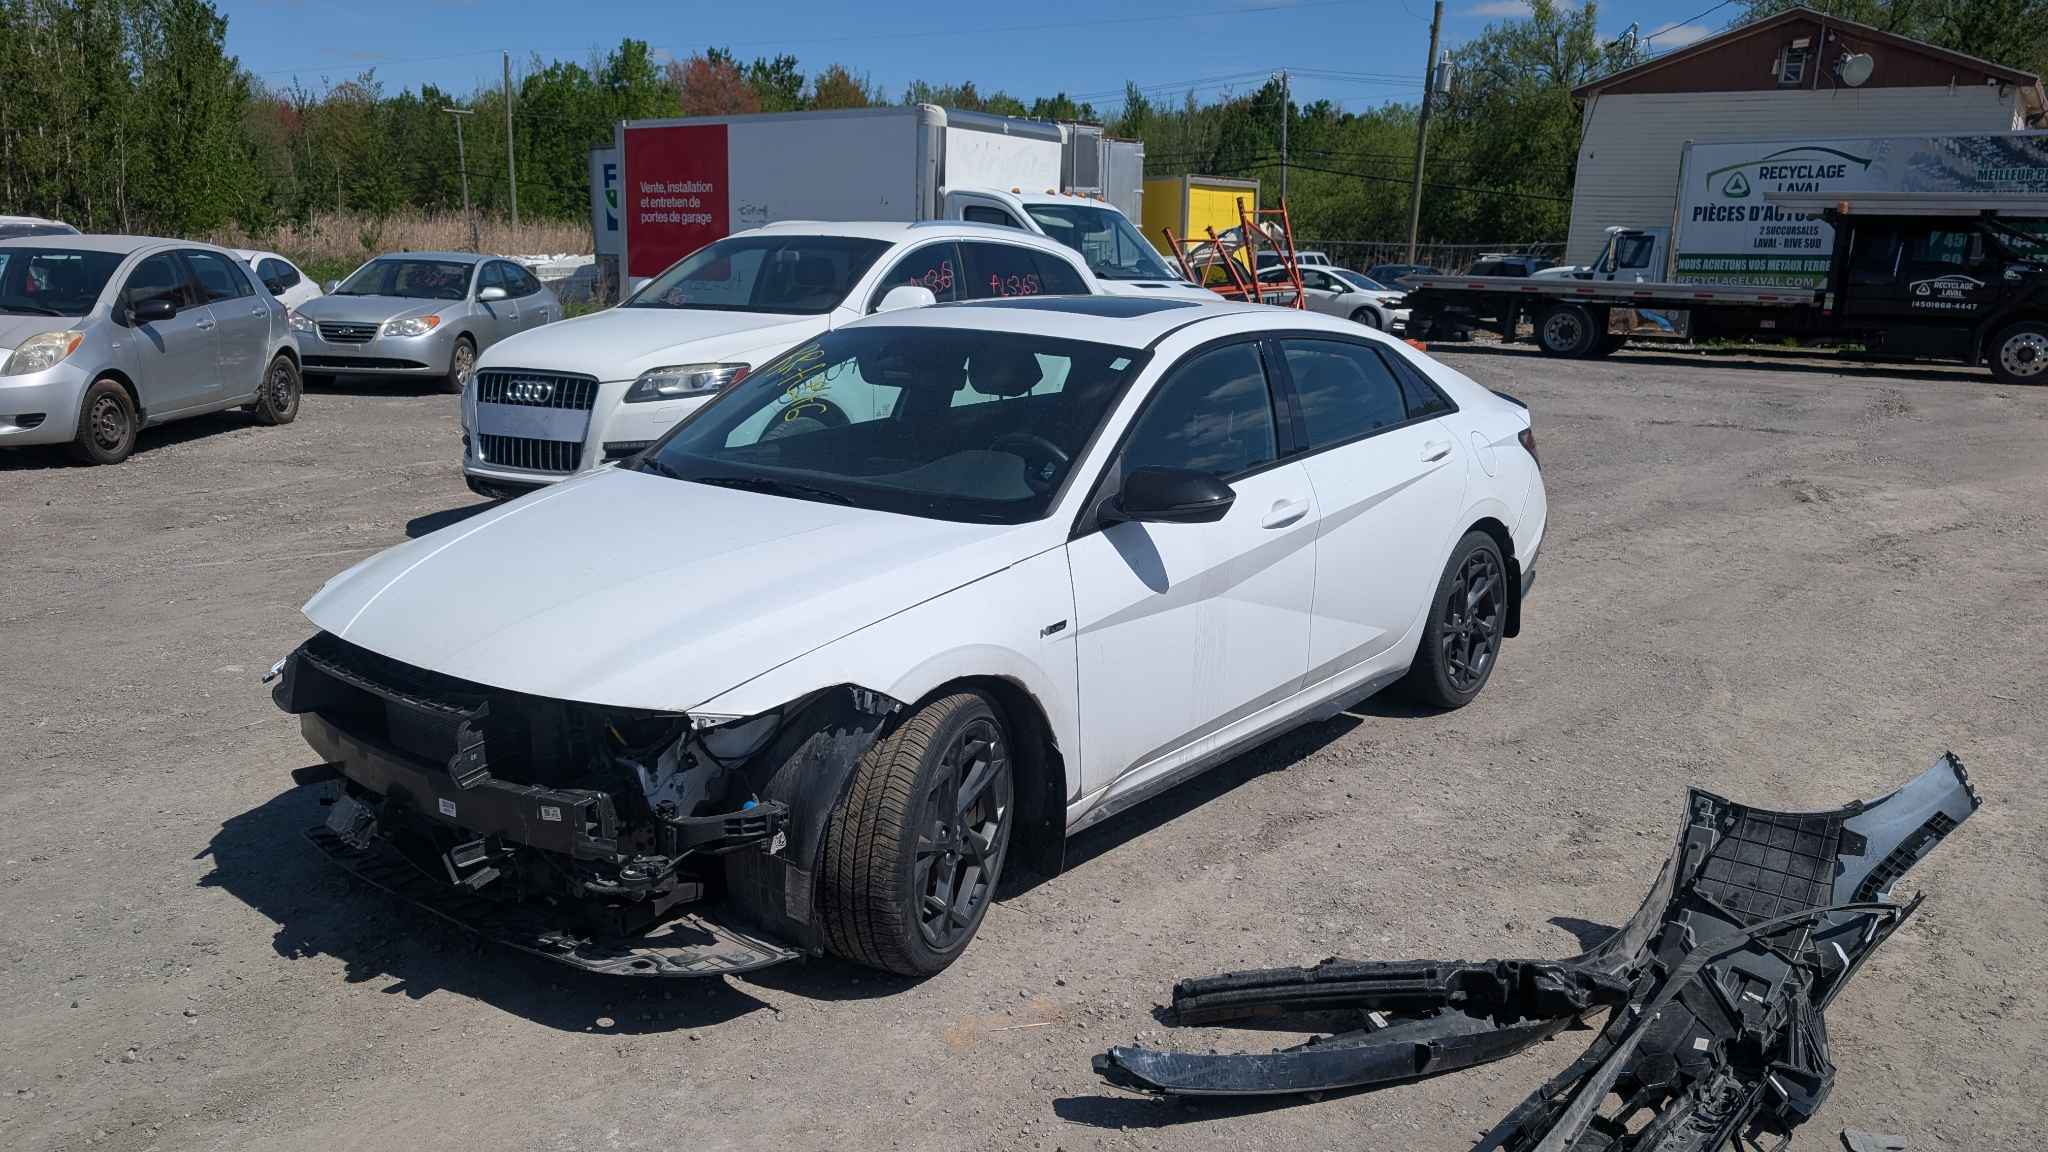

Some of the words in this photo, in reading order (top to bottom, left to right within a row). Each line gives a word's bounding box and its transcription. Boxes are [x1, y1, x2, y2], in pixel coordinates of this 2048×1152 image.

[1759, 164, 1846, 179] RECYCLAGE
[640, 181, 665, 194] Vente,
[667, 180, 713, 193] installation
[640, 196, 650, 208] et
[651, 196, 688, 209] entretien
[689, 196, 701, 208] de
[641, 212, 667, 224] portes
[669, 211, 680, 223] de
[681, 213, 712, 226] garage
[1692, 203, 1745, 222] PIÈCES
[1759, 225, 1766, 235] 2
[1766, 225, 1819, 235] SUCCURSALES
[1753, 238, 1777, 249] LAVAL
[1783, 238, 1805, 249] RIVE
[1805, 238, 1822, 249] SUD
[1679, 258, 1702, 270] NOUS
[1703, 258, 1747, 271] ACHETONS
[1748, 259, 1766, 271] VOS
[1934, 281, 1975, 290] RECYCLAGE
[1942, 289, 1963, 297] LAVAL
